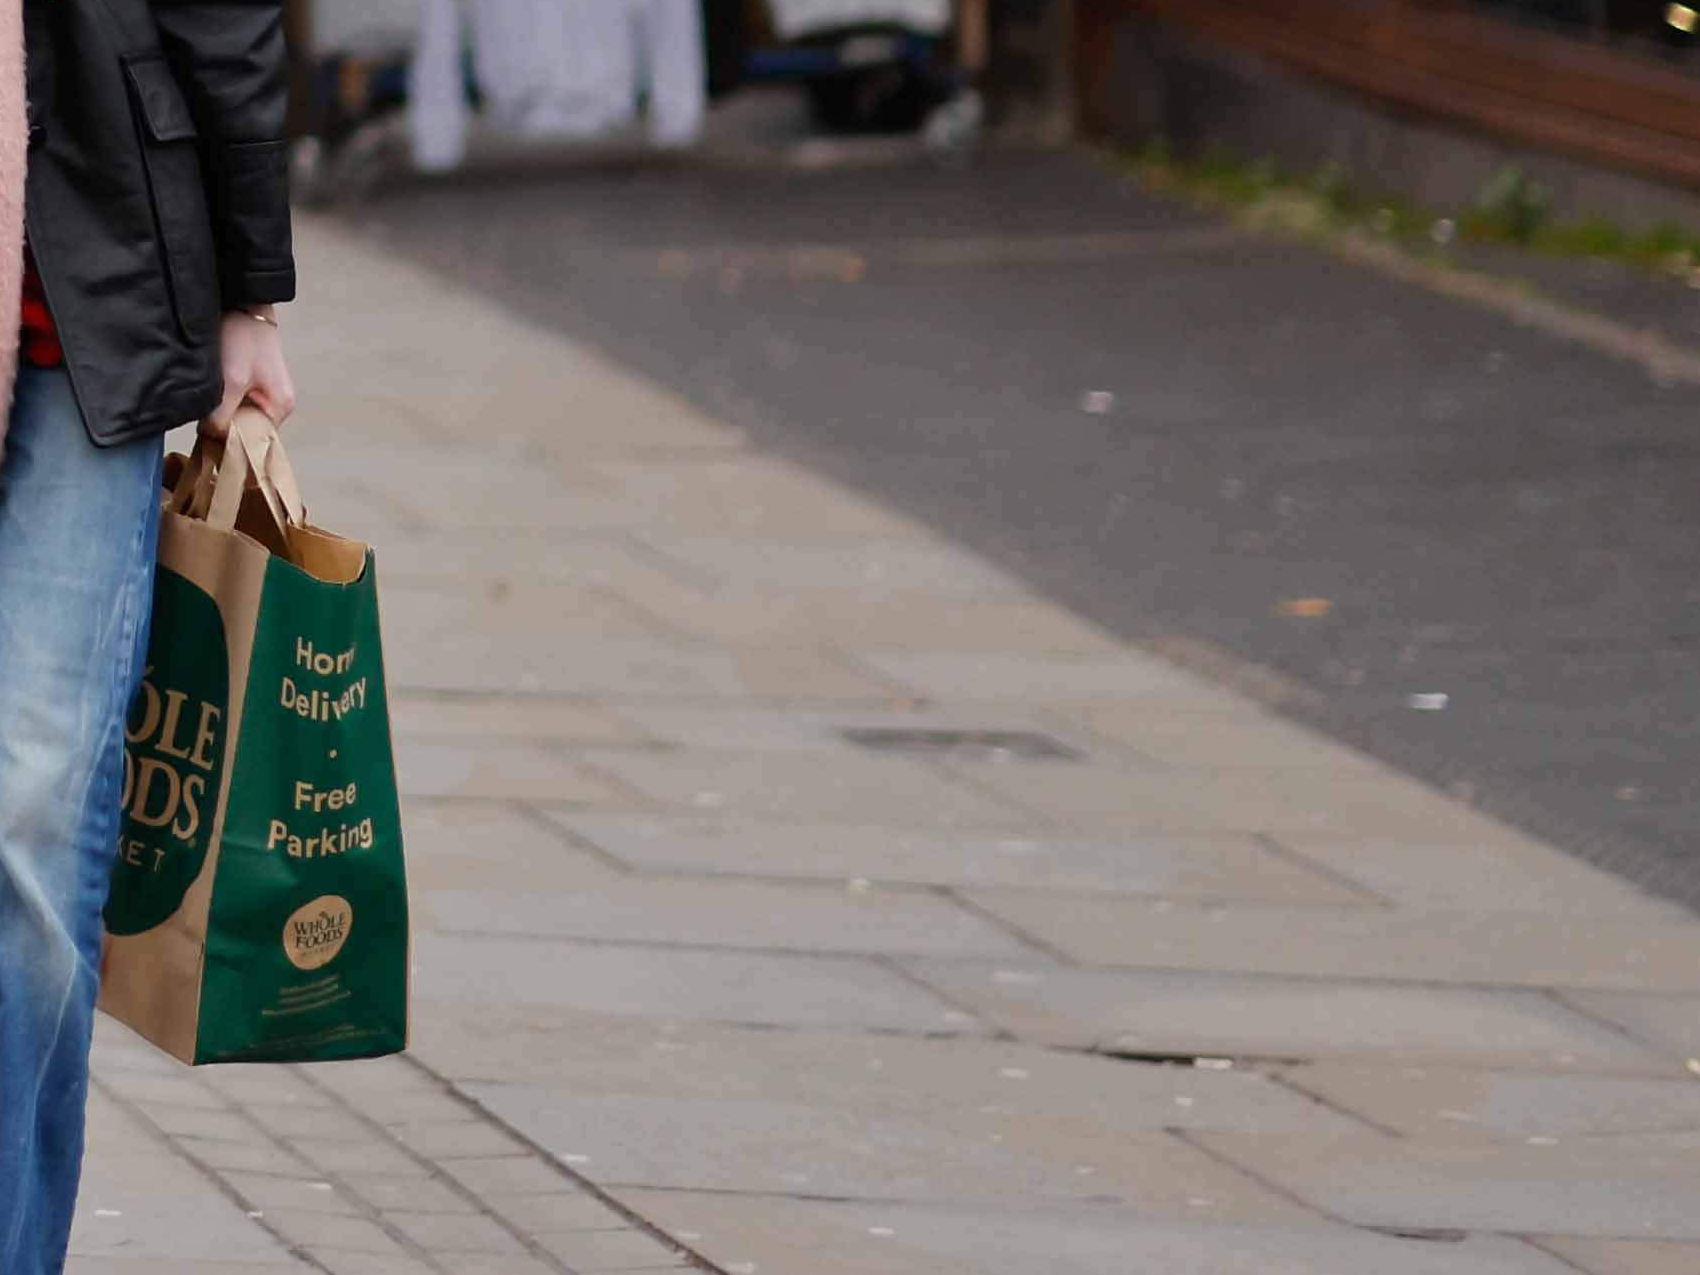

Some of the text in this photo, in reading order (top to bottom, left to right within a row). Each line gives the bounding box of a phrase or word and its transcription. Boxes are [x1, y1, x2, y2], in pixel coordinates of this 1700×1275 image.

[124, 680, 222, 772] OLE
[294, 779, 357, 813] Free
[266, 817, 374, 859] Parking
[294, 911, 346, 936] WHOLE
[295, 927, 343, 948] FOODS
